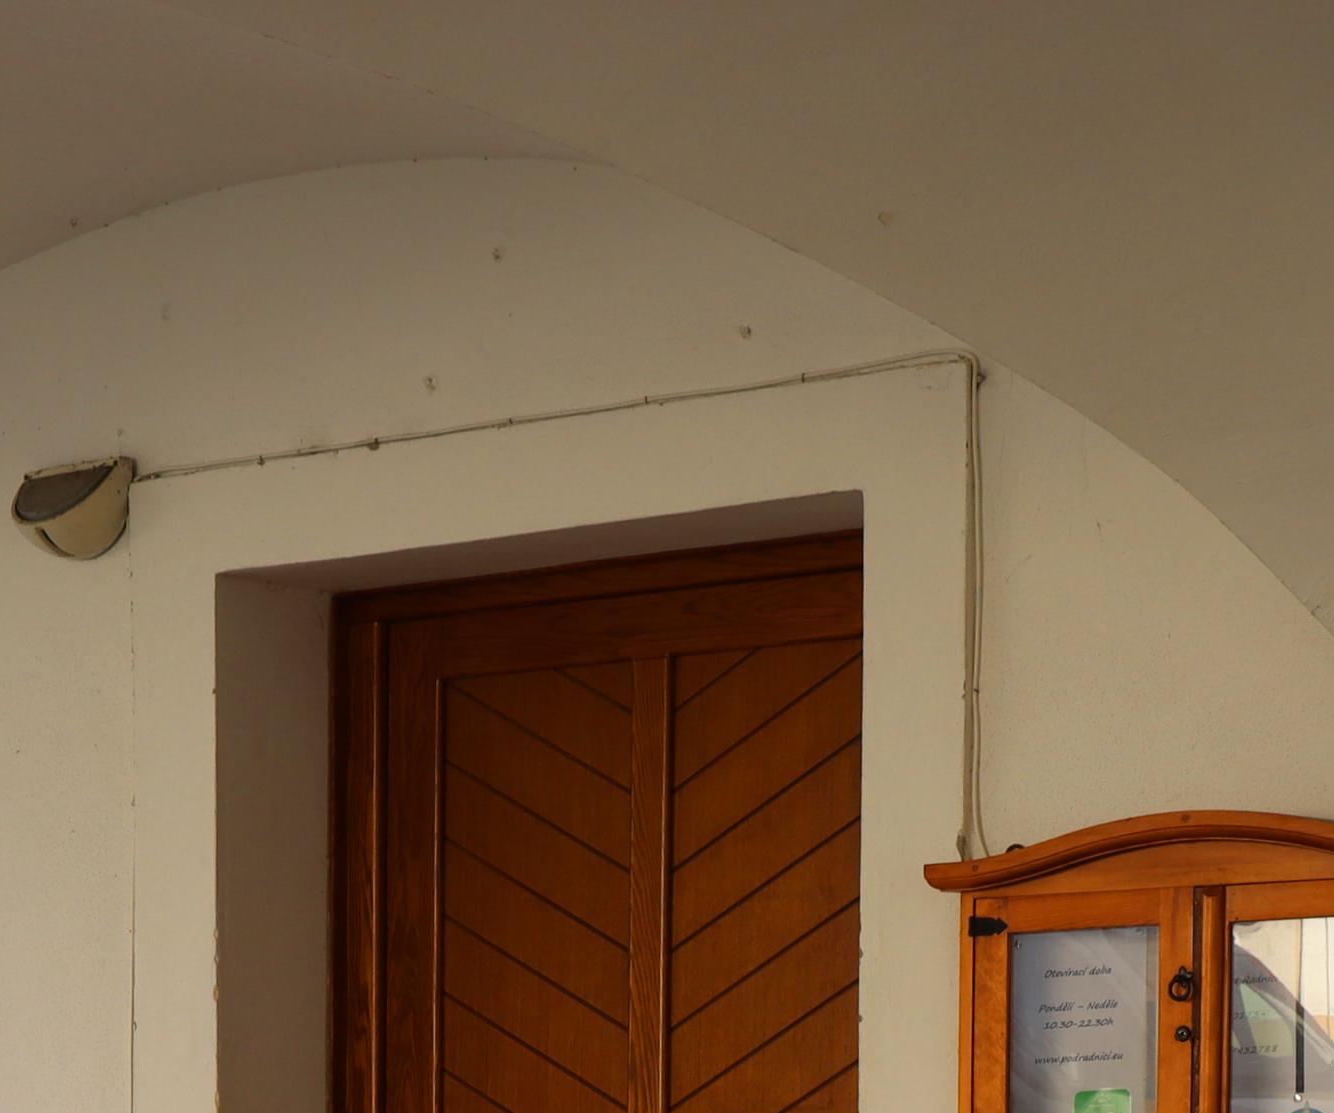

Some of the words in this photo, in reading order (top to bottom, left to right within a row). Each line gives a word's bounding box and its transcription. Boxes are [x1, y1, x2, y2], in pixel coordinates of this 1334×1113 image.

[1089, 964, 1112, 976] doba
[1039, 1001, 1075, 1013] Pondělí
[1087, 999, 1119, 1010] Neděle
